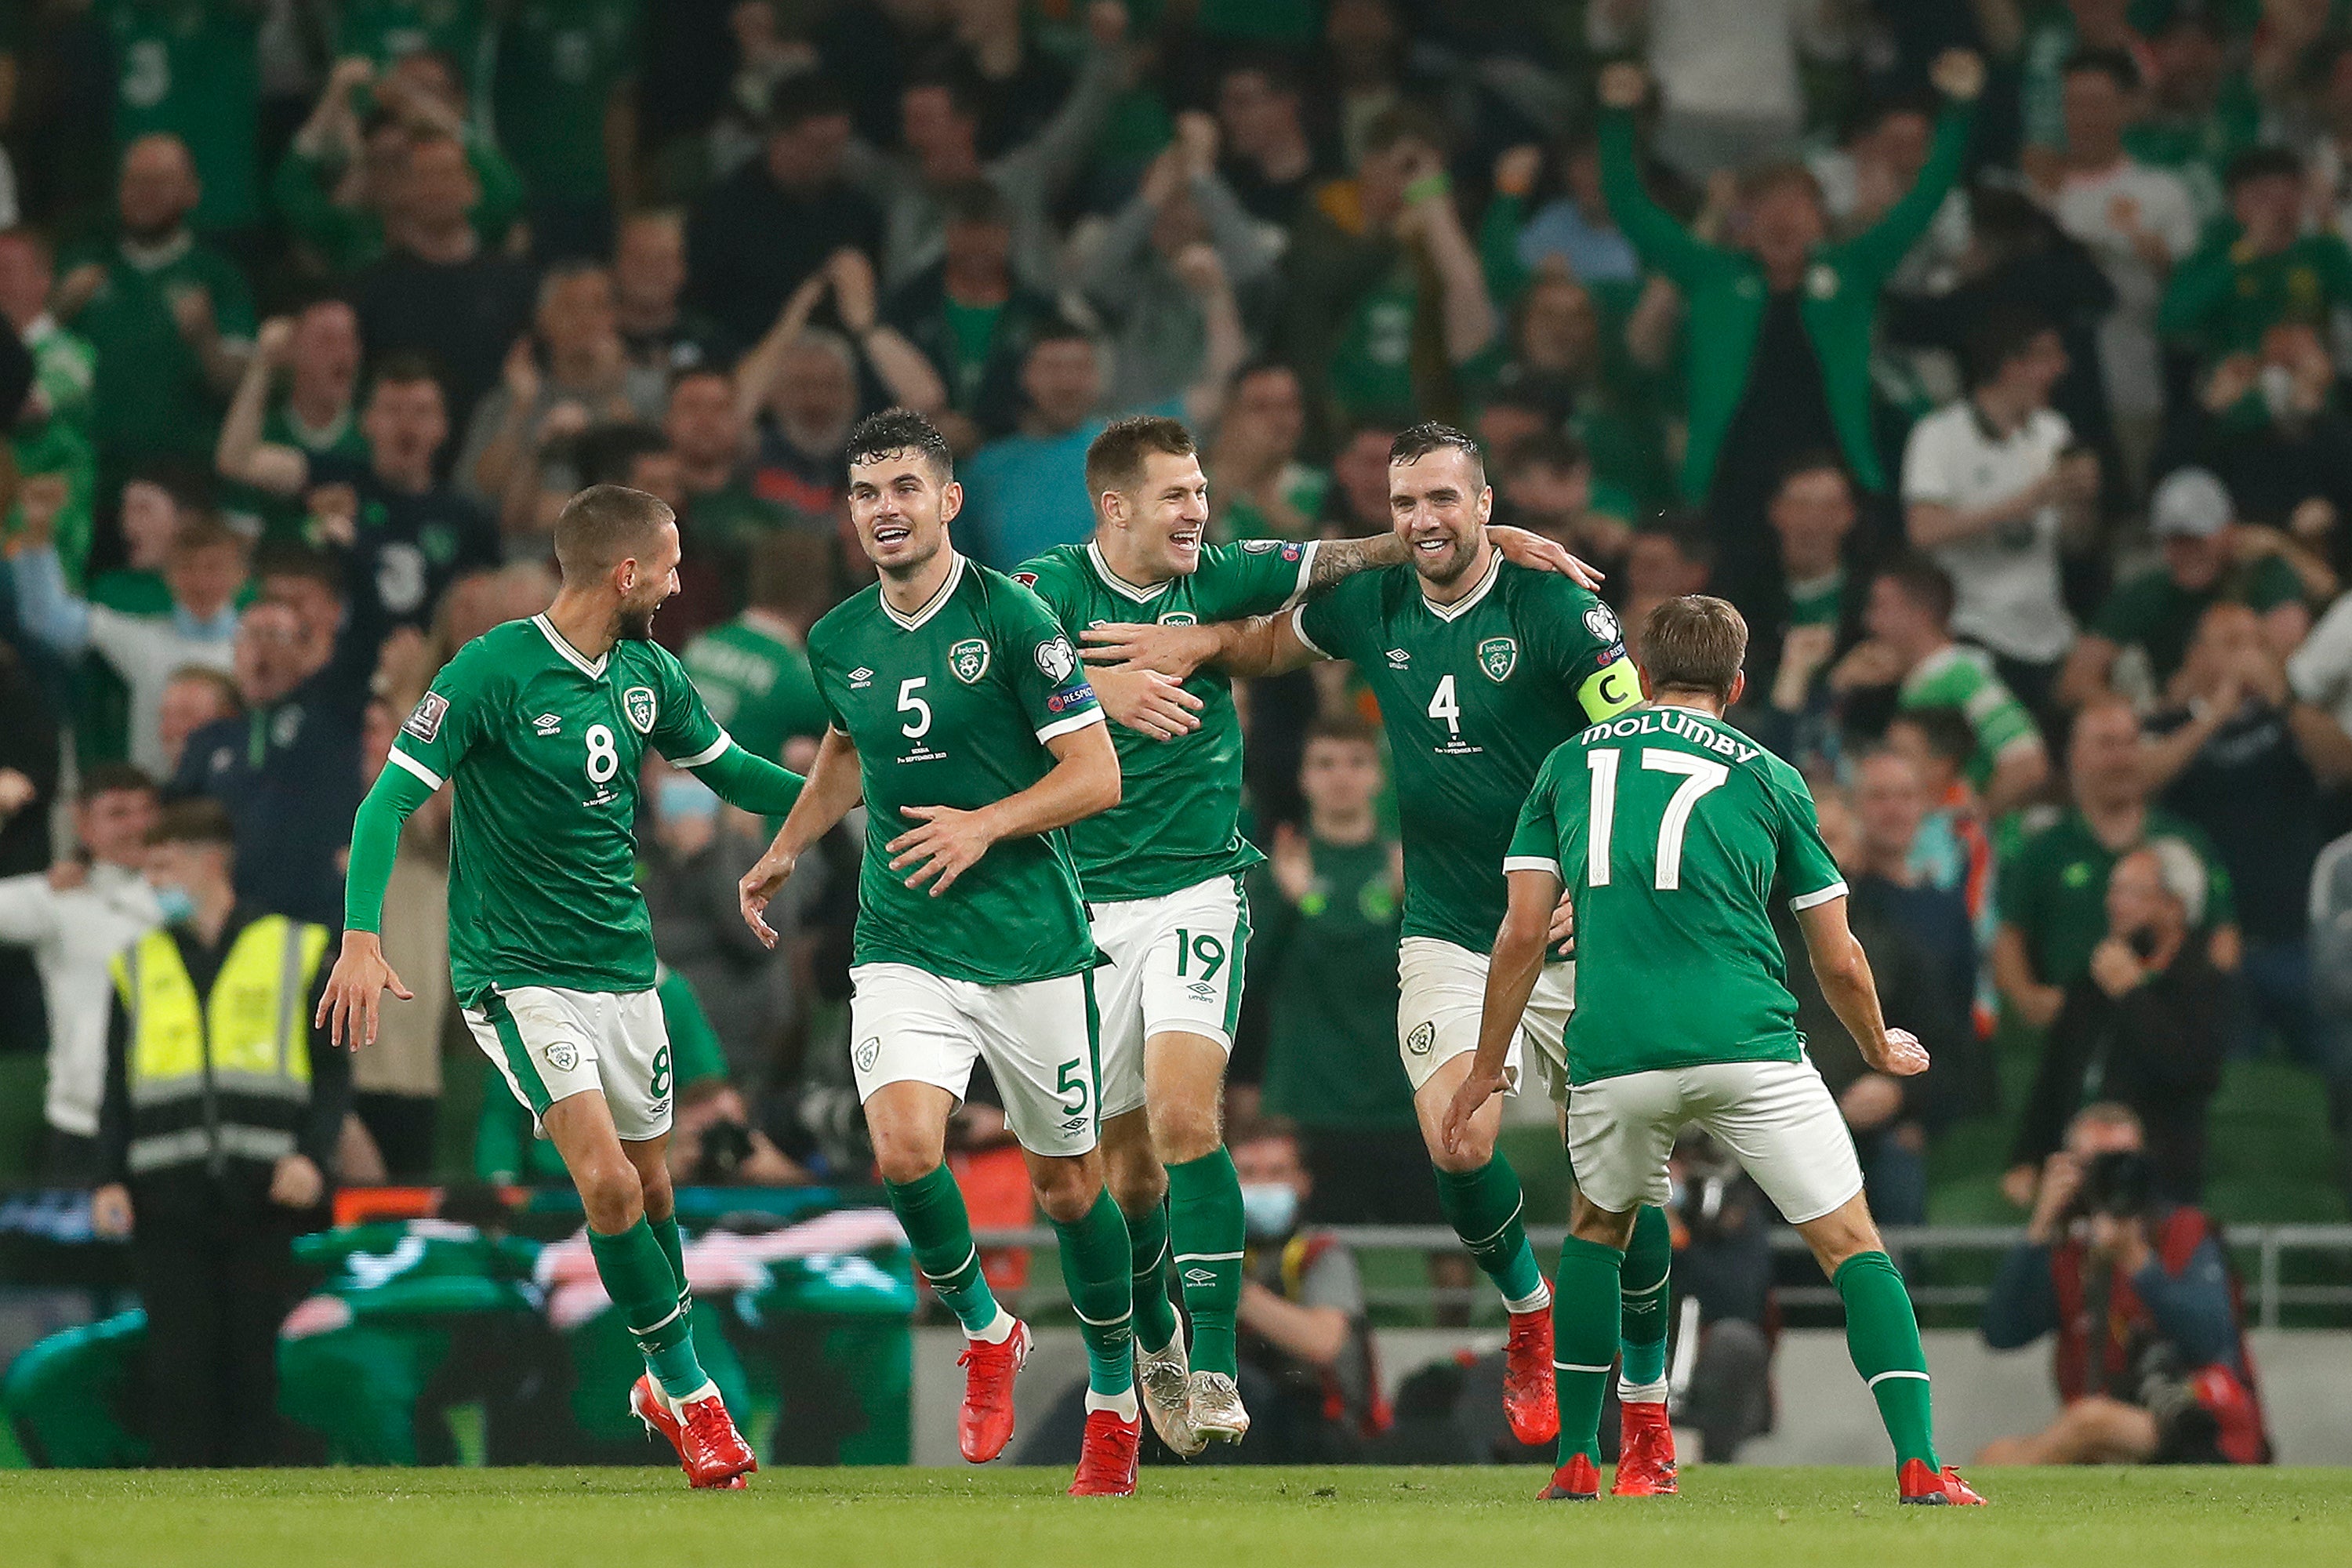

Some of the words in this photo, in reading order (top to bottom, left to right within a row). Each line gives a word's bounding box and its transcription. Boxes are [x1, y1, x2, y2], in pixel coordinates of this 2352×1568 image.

[957, 644, 981, 654] Ireland
[1485, 643, 1509, 652] Ireland
[898, 677, 931, 739] 5
[1428, 675, 1460, 734] 4
[1599, 674, 1628, 704] C
[586, 724, 619, 783] 8
[1581, 711, 1760, 764] MOLUMBY
[1588, 748, 1730, 890] 17
[1176, 929, 1225, 982] 19
[1189, 993, 1214, 1004] umbro
[651, 1045, 670, 1098] 8
[1057, 1057, 1087, 1116] 5
